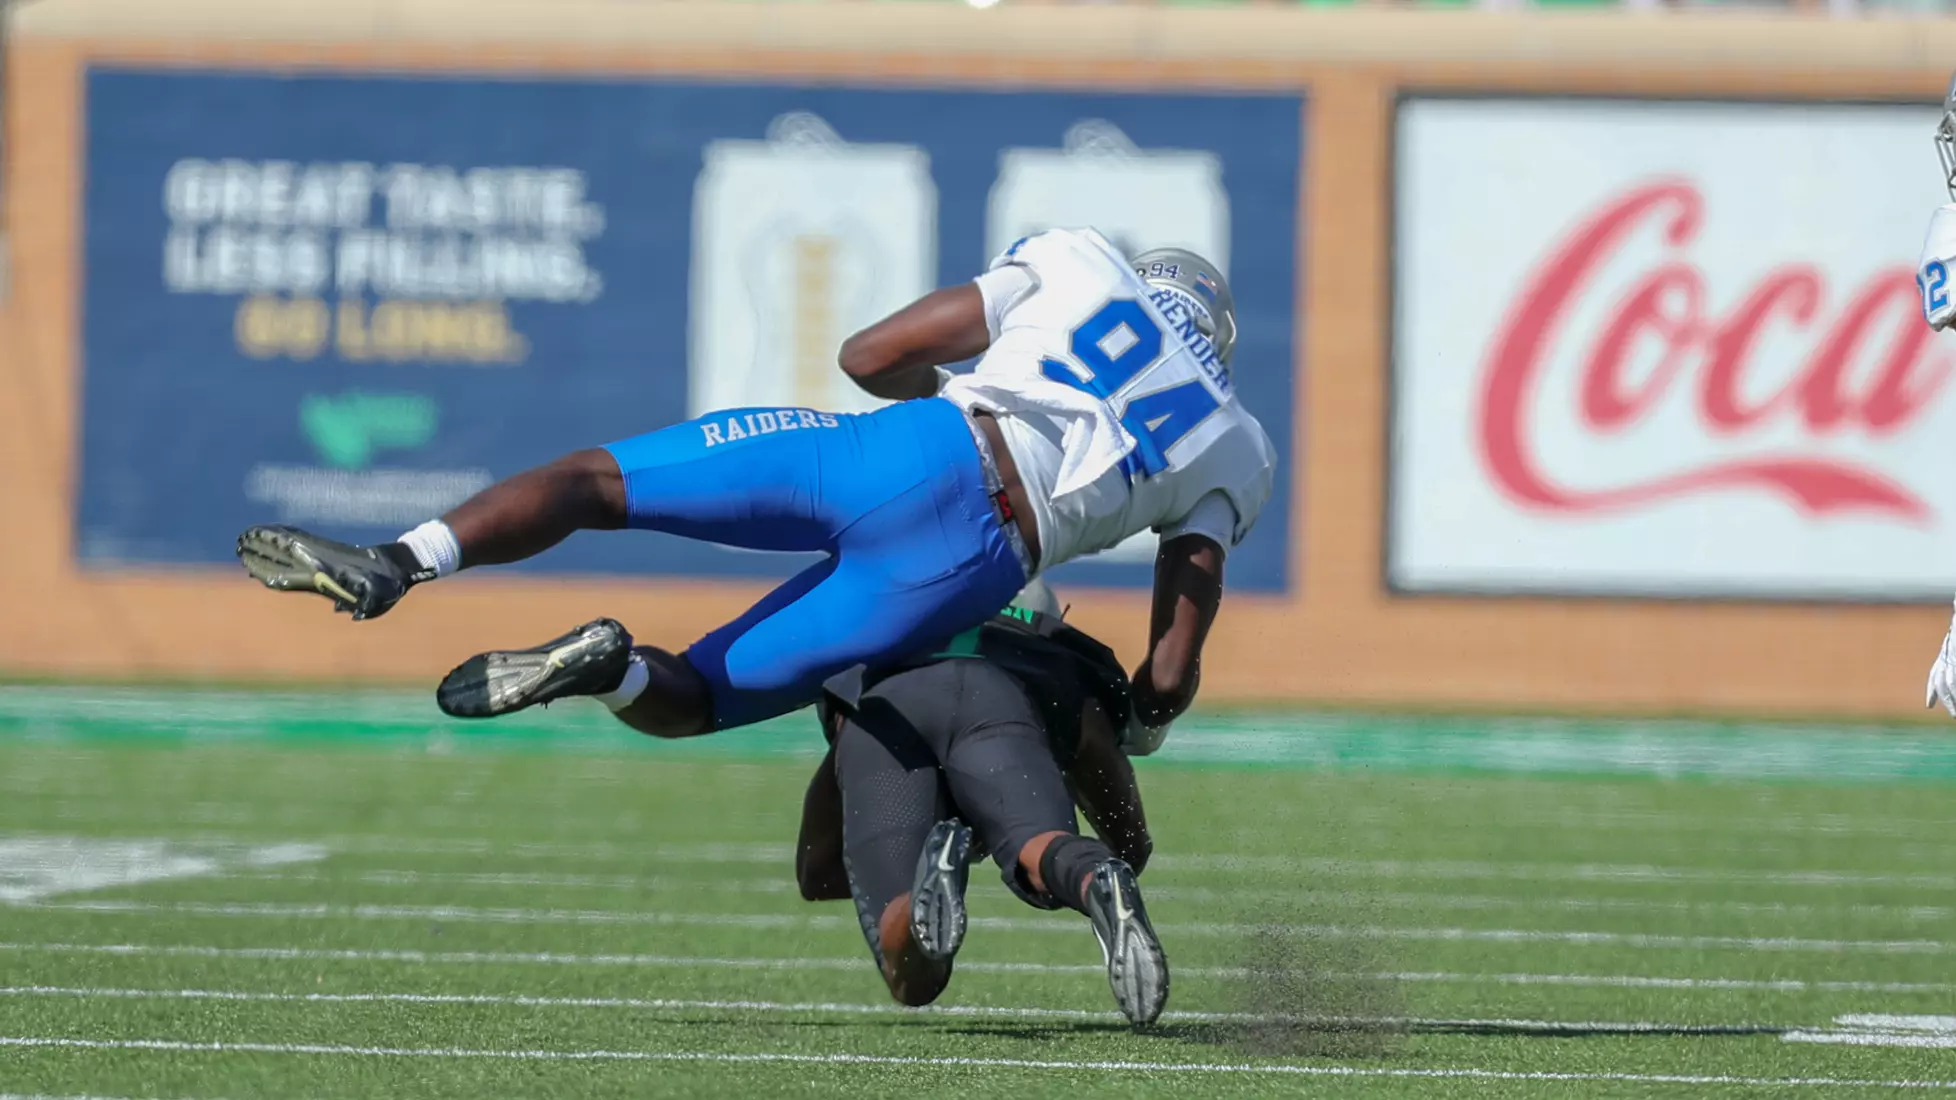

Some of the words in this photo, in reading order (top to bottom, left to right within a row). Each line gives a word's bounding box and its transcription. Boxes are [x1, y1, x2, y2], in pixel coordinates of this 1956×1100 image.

[165, 159, 376, 228] GREAT
[165, 226, 330, 293] LESS
[1149, 261, 1179, 279] 94
[1916, 260, 1948, 318] 2
[235, 293, 331, 361] GO
[1038, 297, 1223, 479] 94
[700, 409, 839, 447] RAIDERS
